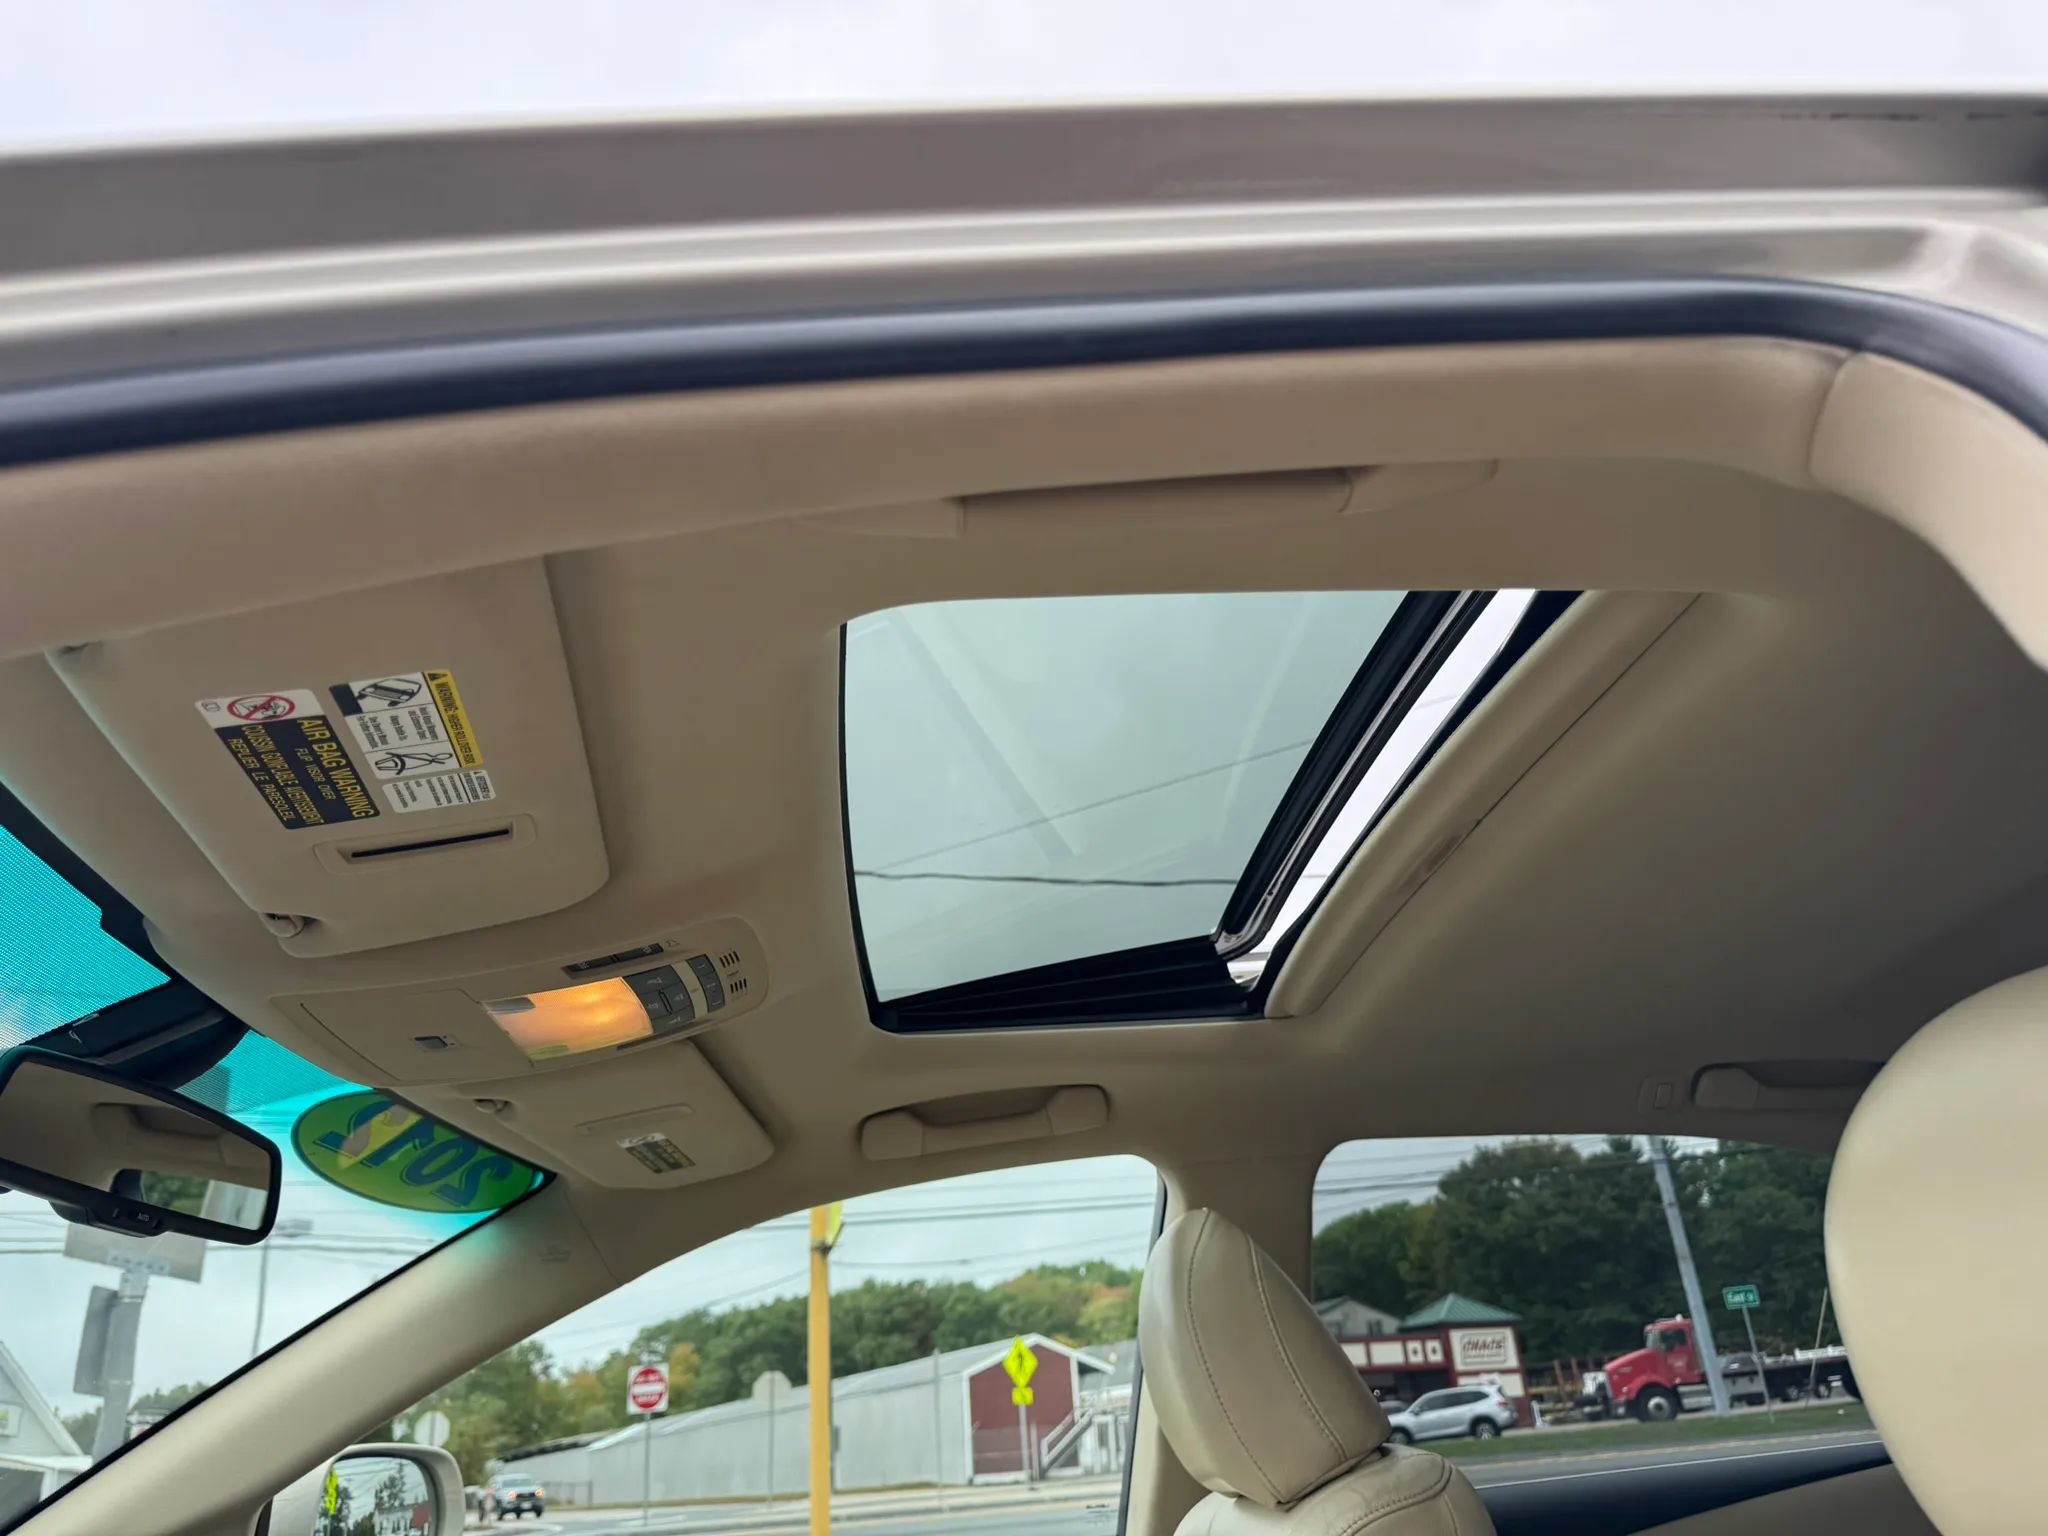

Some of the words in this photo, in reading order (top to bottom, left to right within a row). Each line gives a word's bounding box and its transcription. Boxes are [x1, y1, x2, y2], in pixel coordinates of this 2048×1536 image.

[296, 719, 331, 740] AIR
[227, 738, 261, 769] REPLIER
[312, 743, 346, 767] BAG
[241, 725, 274, 753] COUSSIN
[260, 752, 299, 786] GONFLABLE
[284, 786, 325, 826] AVERTISSEMENT
[251, 771, 270, 781] LE
[294, 747, 314, 763] FLIP
[305, 765, 326, 782] VISOR
[317, 784, 337, 801] OVER
[260, 784, 296, 821] PARESOLEIL
[328, 768, 375, 818] WARNING
